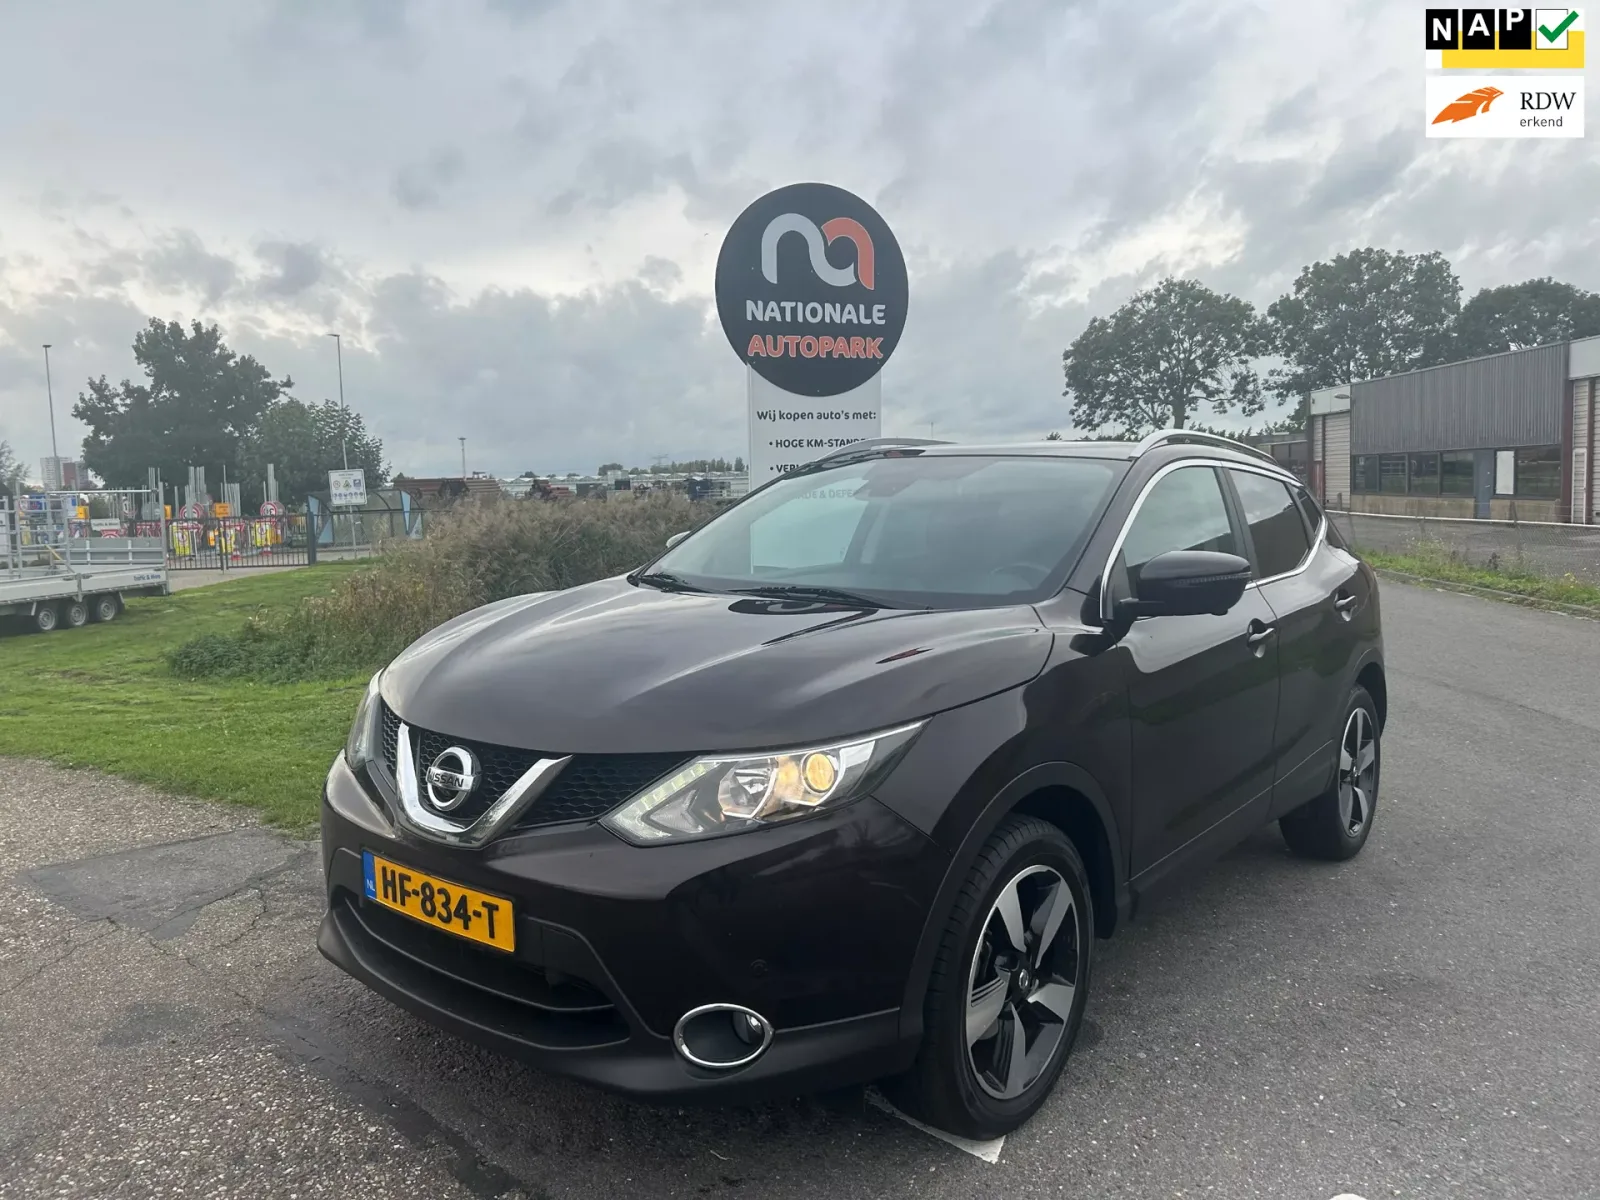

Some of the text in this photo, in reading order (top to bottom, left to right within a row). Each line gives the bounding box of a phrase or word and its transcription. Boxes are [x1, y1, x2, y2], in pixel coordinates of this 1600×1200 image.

[745, 299, 886, 325] NATIONALE
[747, 334, 884, 359] AUTOPARK
[756, 410, 877, 422] Wij kopen auto's met:
[775, 438, 866, 448] HOGE KM-STAN
[366, 878, 376, 892] NL
[381, 865, 499, 939] HF-834-T
